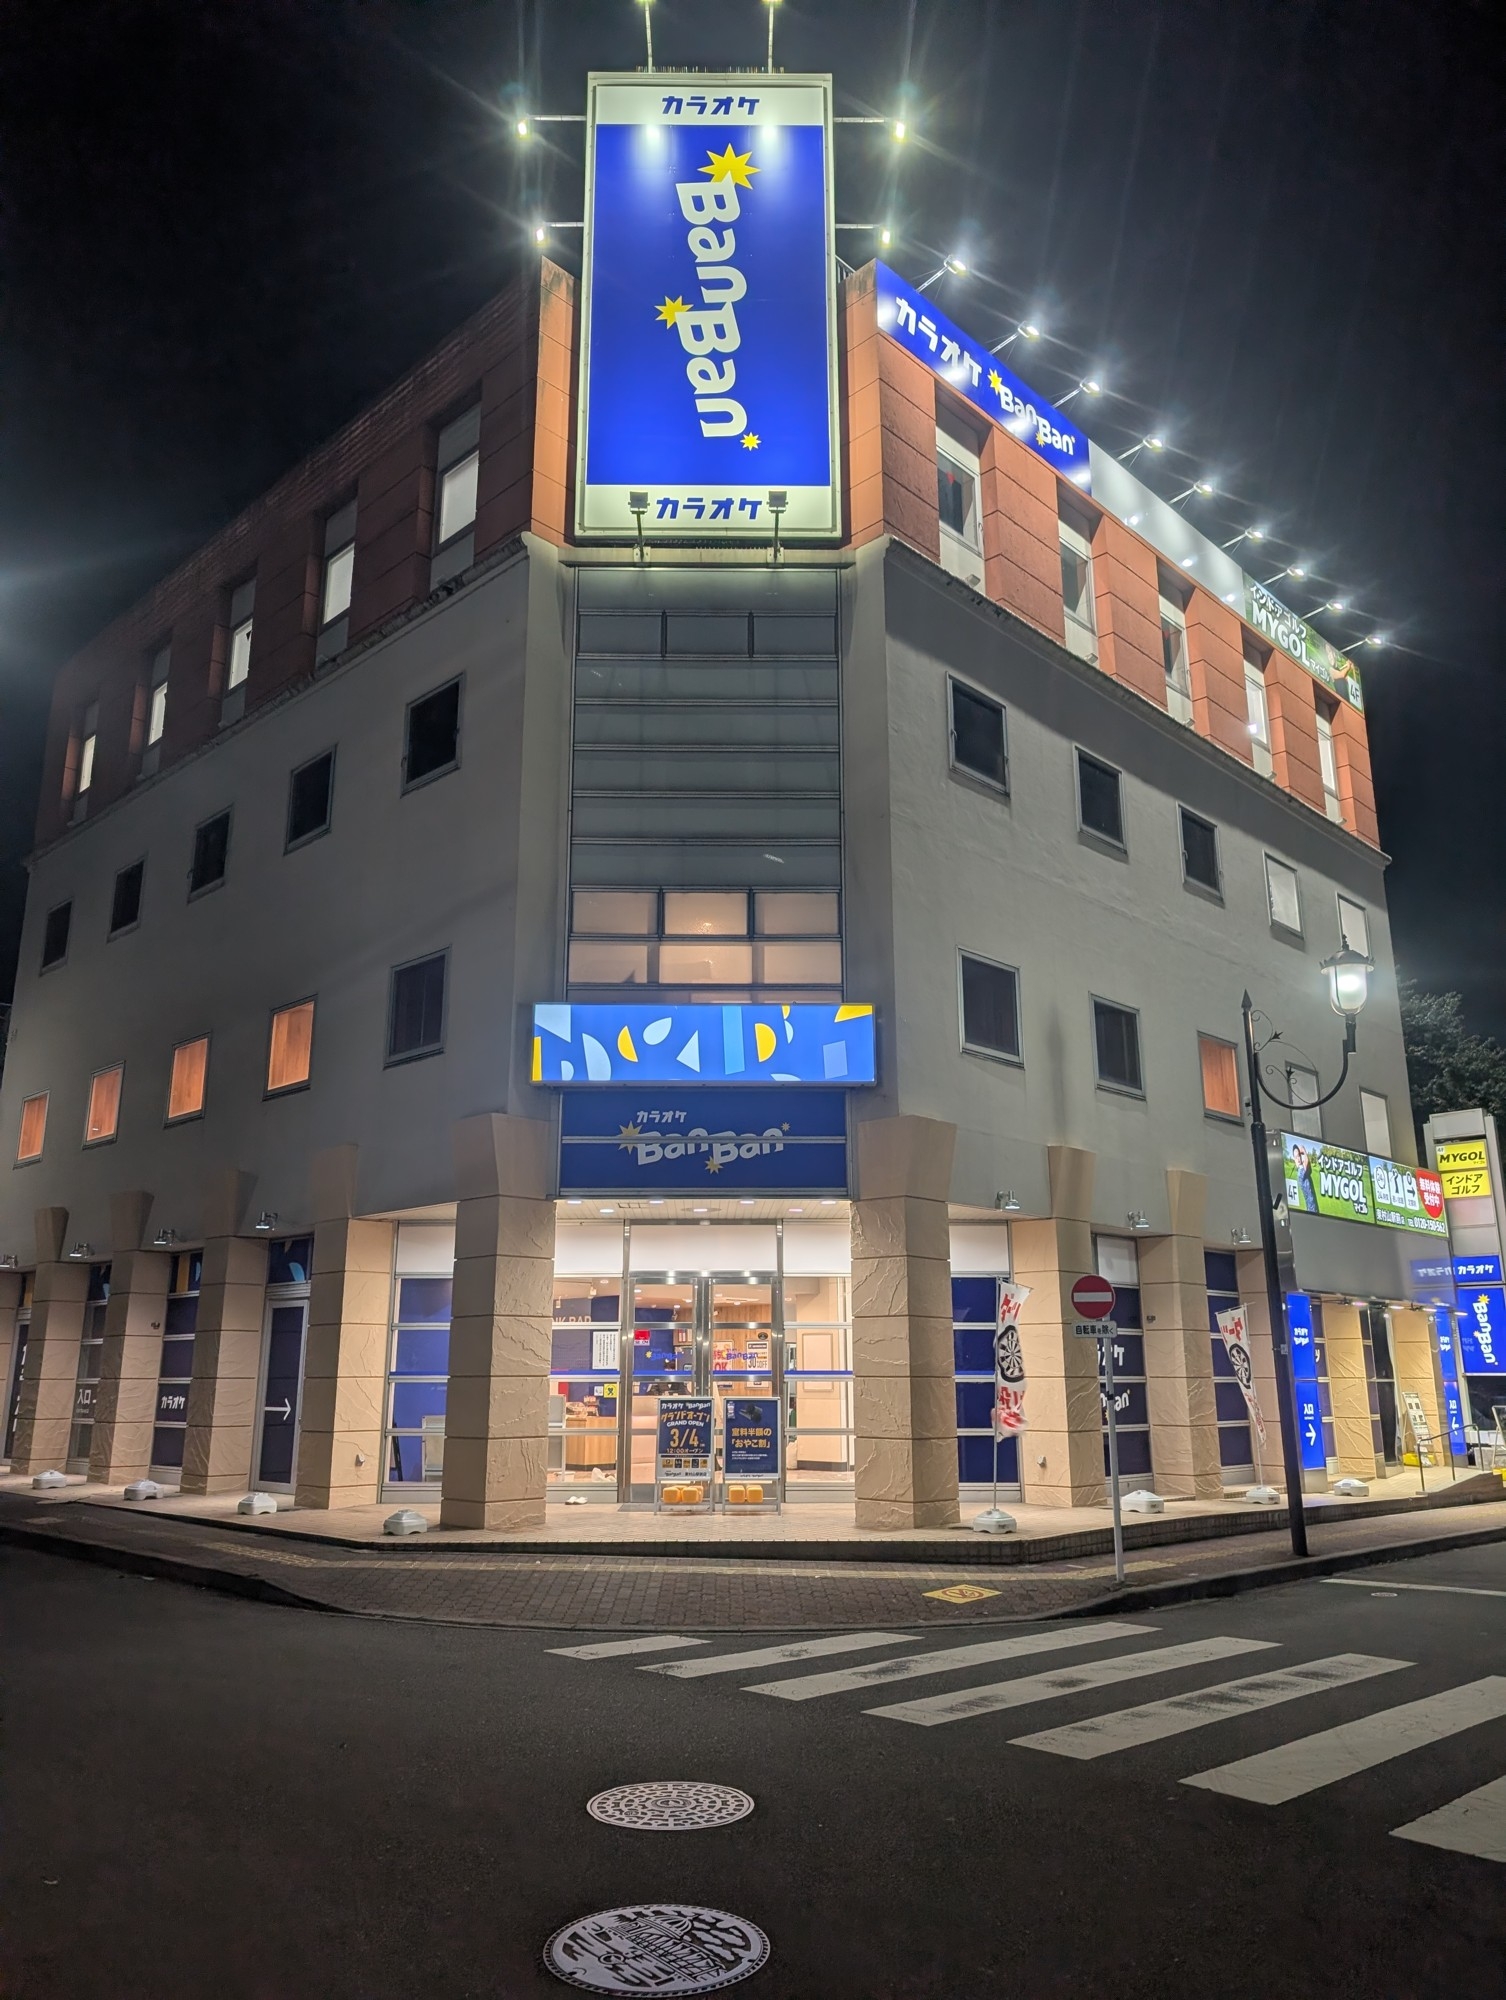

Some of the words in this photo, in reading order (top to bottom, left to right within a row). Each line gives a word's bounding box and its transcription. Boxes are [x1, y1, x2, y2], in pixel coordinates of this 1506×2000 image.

[661, 96, 760, 115] カラオケ
[676, 172, 748, 438] BanBan
[896, 297, 982, 387] カラオケ
[1000, 384, 1074, 456] BanBan
[655, 497, 762, 520] カラオケ
[1250, 585, 1307, 639] インドアゴルフ
[1252, 600, 1311, 667] MYGOL
[1350, 687, 1360, 701] 4F
[636, 1110, 687, 1123] カラオケ
[637, 1128, 784, 1165] BanBan
[1318, 1155, 1363, 1178] インドアゴルフ
[1440, 1151, 1485, 1164] MYGOL
[1320, 1171, 1367, 1203] MYGOL
[1446, 1174, 1483, 1185] インドア
[1288, 1184, 1298, 1201] 4F
[1451, 1185, 1480, 1195] ゴルフ
[1458, 1265, 1494, 1275] カラオケ
[1076, 1324, 1114, 1335] 自転車を除く
[1472, 1302, 1496, 1363] BanBan
[77, 1389, 91, 1404] 入口
[161, 1396, 186, 1409] カラオケ
[661, 1411, 710, 1423] グランドオープン
[670, 1428, 699, 1448] 3/4
